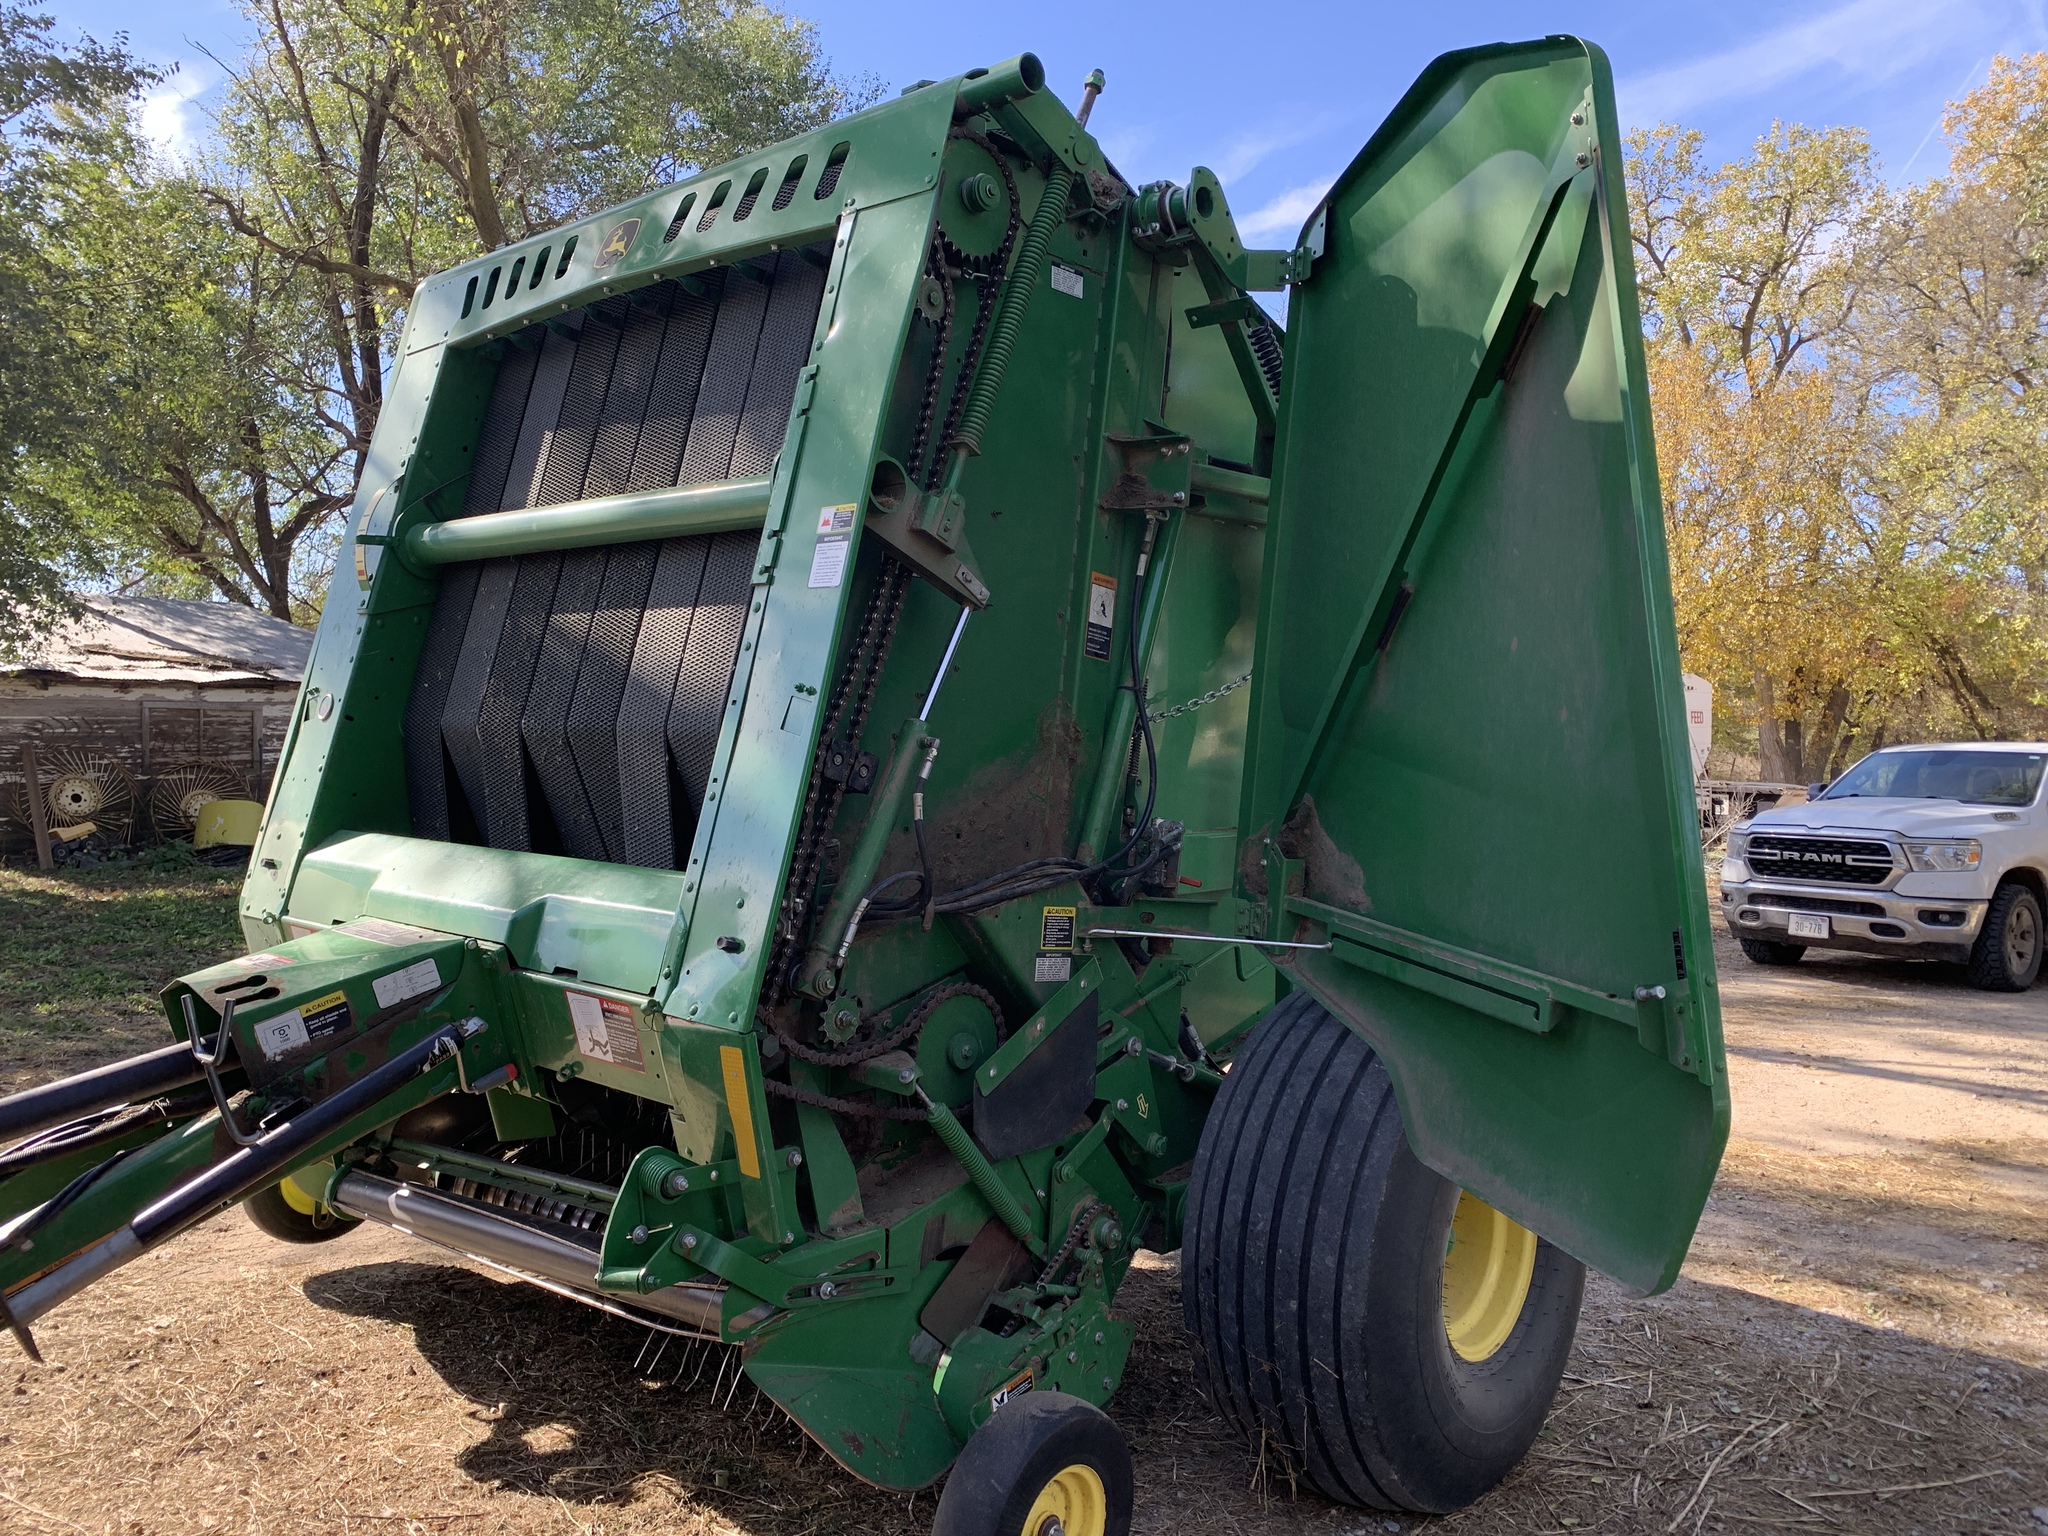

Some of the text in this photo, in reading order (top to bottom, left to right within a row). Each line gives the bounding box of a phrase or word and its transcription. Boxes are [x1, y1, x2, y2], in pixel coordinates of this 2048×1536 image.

[1690, 710, 1704, 724] FEED
[1782, 851, 1842, 863] RAM
[312, 995, 341, 1011] CAUTION
[607, 1002, 630, 1014] DANGER
